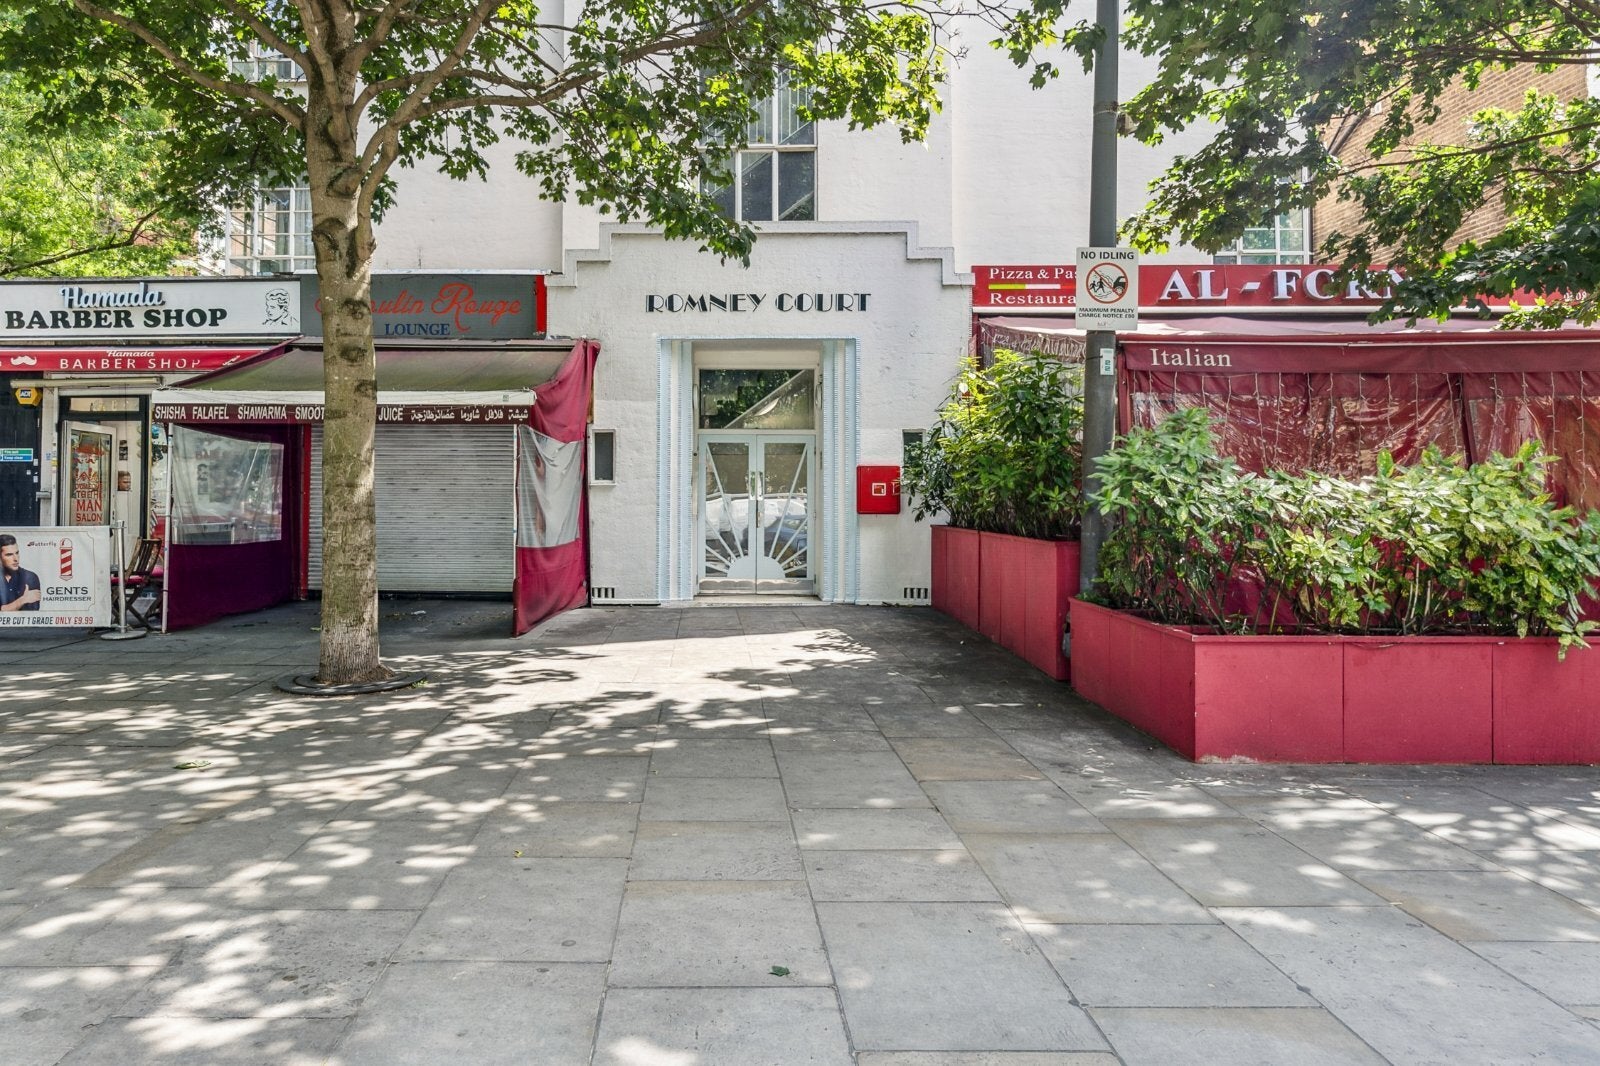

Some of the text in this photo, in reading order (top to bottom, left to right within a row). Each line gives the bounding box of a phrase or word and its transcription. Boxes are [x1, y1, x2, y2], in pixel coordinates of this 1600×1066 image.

[1080, 251, 1135, 260] NO IDLING
[989, 267, 1033, 279] Pizza
[1037, 268, 1049, 279] &
[1160, 269, 1229, 300] AL
[59, 282, 165, 309] Hamada
[990, 293, 1077, 305] Restaura
[431, 282, 521, 333] Rouge
[645, 293, 871, 312] ROMNEY COURT
[5, 308, 228, 329] BARBER SHOP
[385, 323, 450, 336] LOUNGE
[106, 350, 155, 358] Hamada
[1150, 348, 1232, 367] Italian
[60, 358, 201, 369] BARBER SHOP
[155, 406, 404, 421] SHISHA FALAFEL SHAWARMA SMOOT JUICE
[76, 500, 103, 511] MAN
[76, 513, 103, 522] SALON
[46, 587, 88, 595] GENTS
[13, 617, 25, 625] CUT
[32, 617, 53, 625] GRADE
[55, 617, 72, 625] ONLY
[73, 617, 94, 625] £9.99
